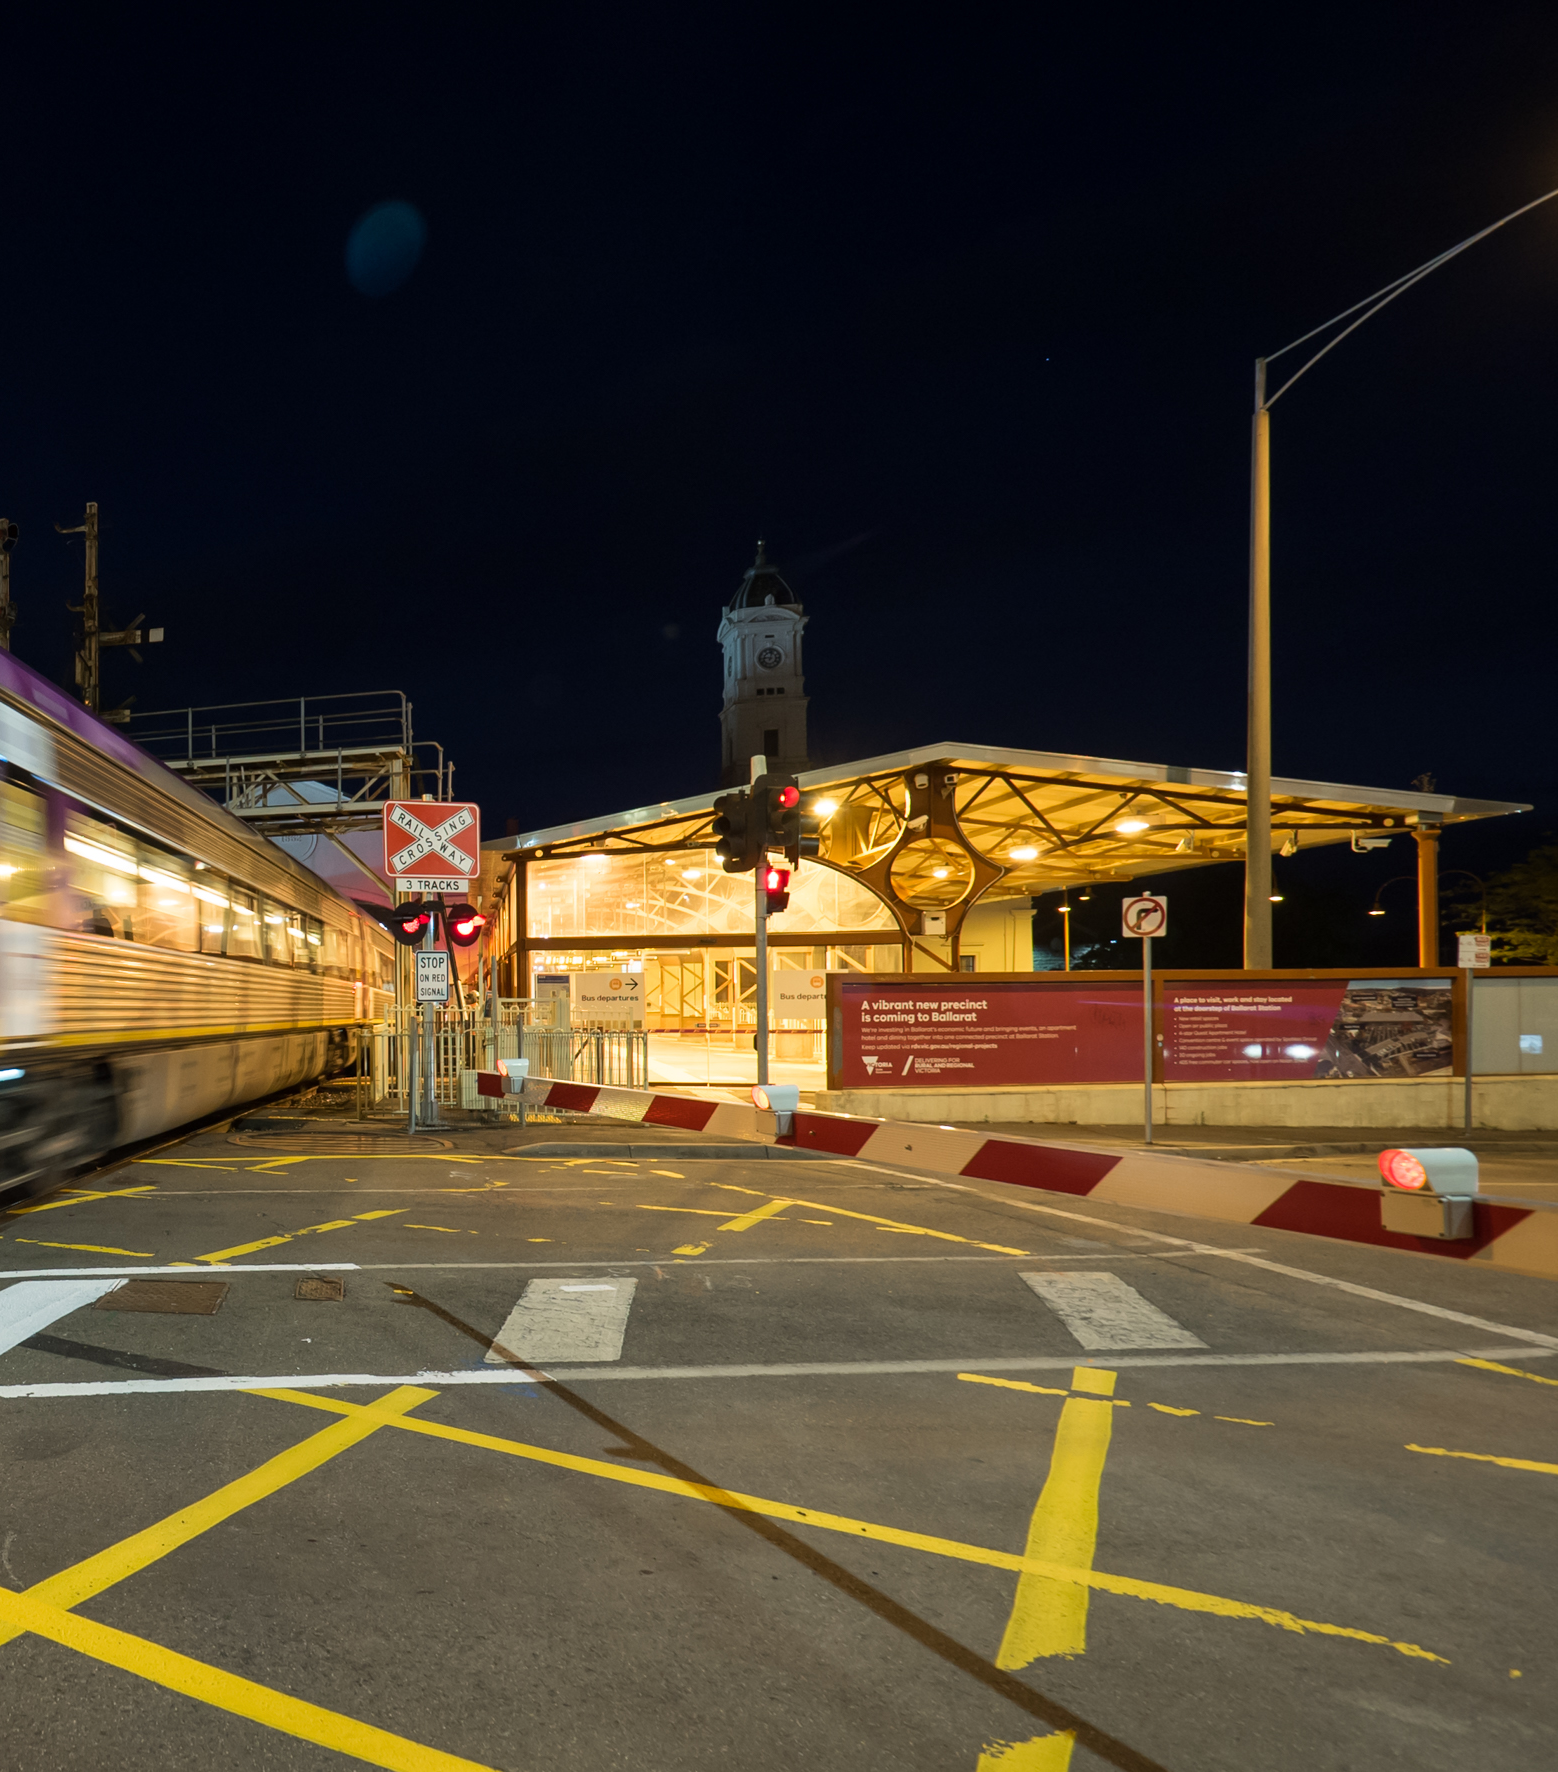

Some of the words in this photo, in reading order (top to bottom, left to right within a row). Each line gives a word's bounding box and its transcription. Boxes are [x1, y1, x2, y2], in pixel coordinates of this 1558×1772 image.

[399, 815, 466, 865] CROSSING
[406, 880, 413, 889] 3
[418, 881, 460, 890] TRACKS
[420, 957, 445, 968] STOP
[420, 974, 430, 982] ON
[432, 974, 446, 982] RED
[420, 988, 446, 996] SIGNAL
[861, 1000, 870, 1010] A
[872, 1000, 914, 1010] vibrant
[916, 1002, 939, 1010] new
[941, 1000, 988, 1011] precinct
[861, 1012, 871, 1022] is
[873, 1012, 915, 1024] coming
[917, 1012, 930, 1022] to
[932, 1012, 977, 1022] Ballarat
